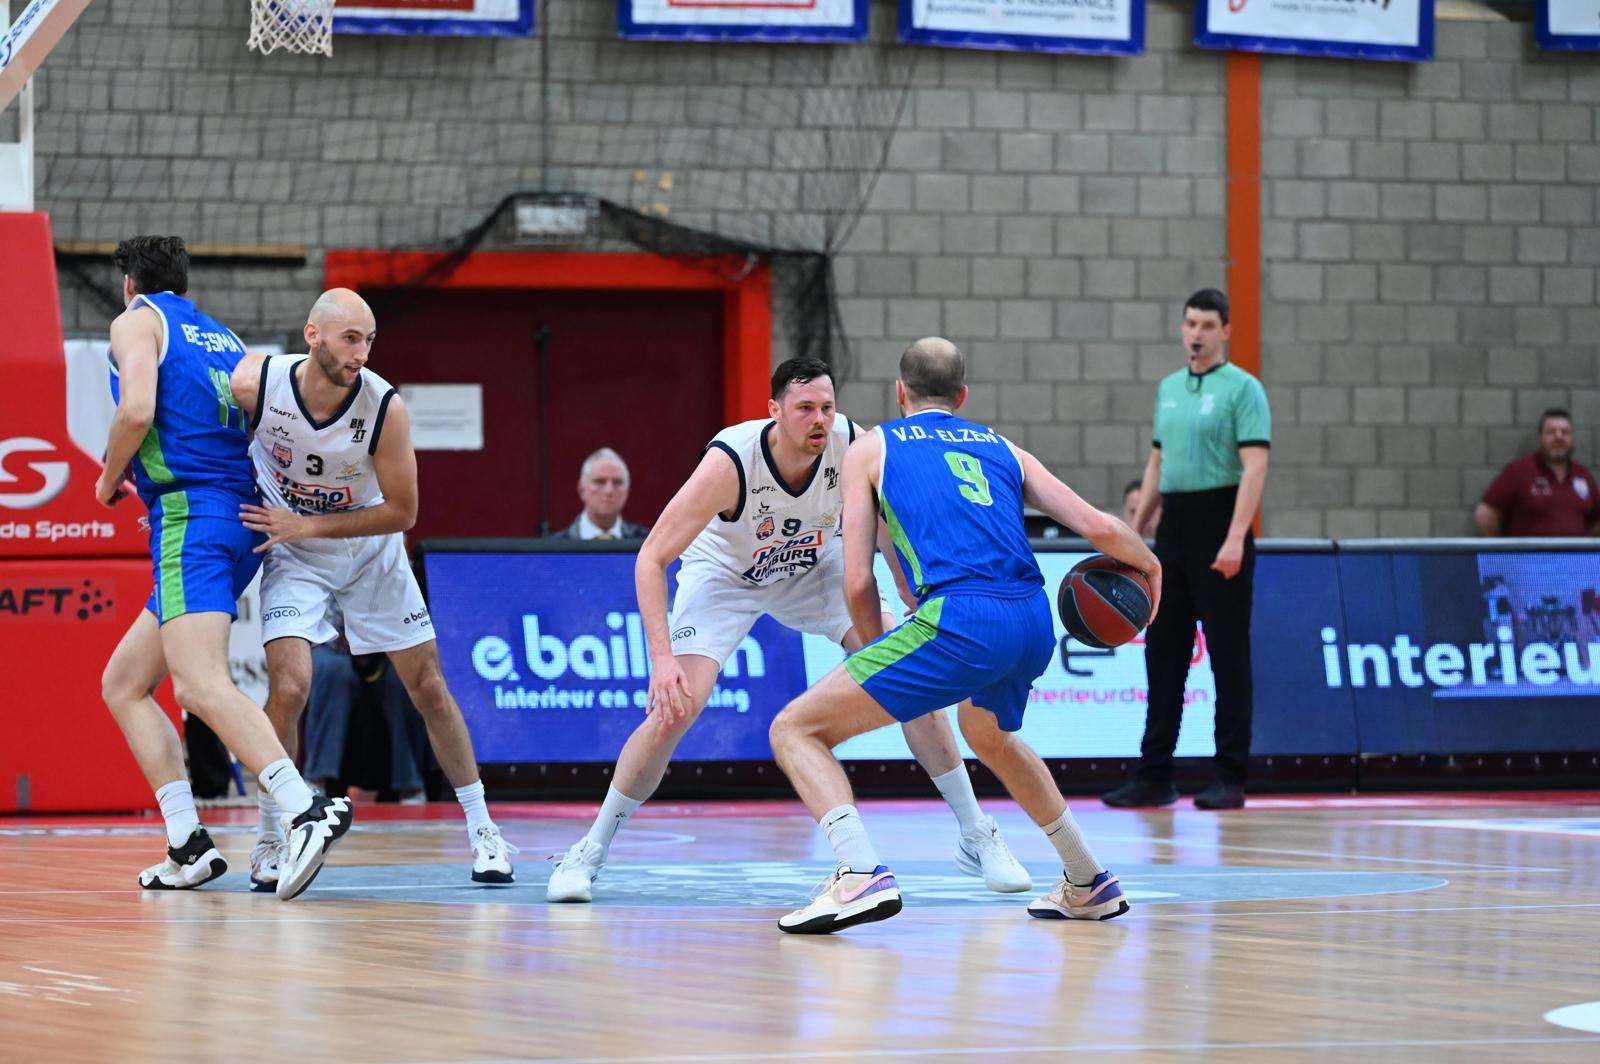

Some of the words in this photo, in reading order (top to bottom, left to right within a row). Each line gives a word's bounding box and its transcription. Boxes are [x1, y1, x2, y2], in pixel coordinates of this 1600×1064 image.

[891, 426, 934, 441] V.D.
[305, 453, 324, 476] 3
[943, 451, 993, 506] 9
[35, 521, 115, 543] Sports
[781, 518, 801, 537] 9
